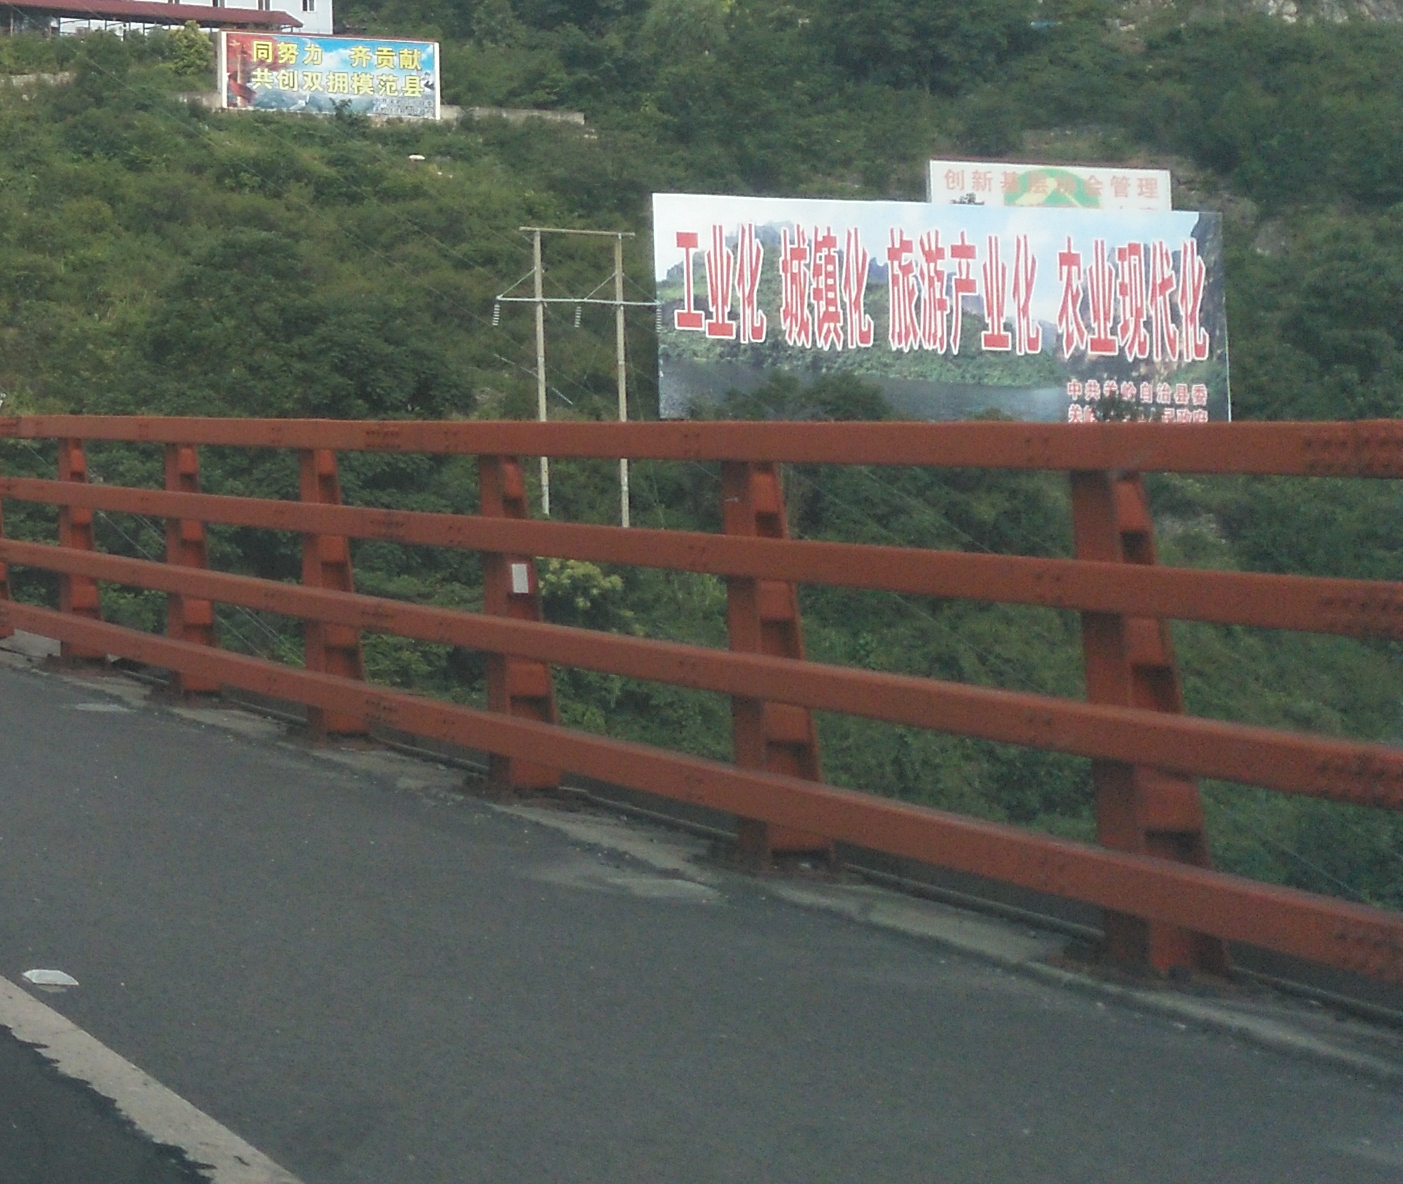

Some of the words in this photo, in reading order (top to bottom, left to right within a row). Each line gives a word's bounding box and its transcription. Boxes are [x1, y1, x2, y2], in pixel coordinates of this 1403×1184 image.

[252, 40, 323, 65] 同努力
[350, 45, 423, 71] 齐贡献
[251, 68, 425, 97] 共创双拥模范县
[674, 222, 767, 344] 工业化
[780, 223, 874, 351] 城镇化
[887, 226, 1043, 356] 旅游产业化
[1057, 234, 1210, 362] 农业现代化
[1066, 378, 1208, 406] 中共关岭自治县委
